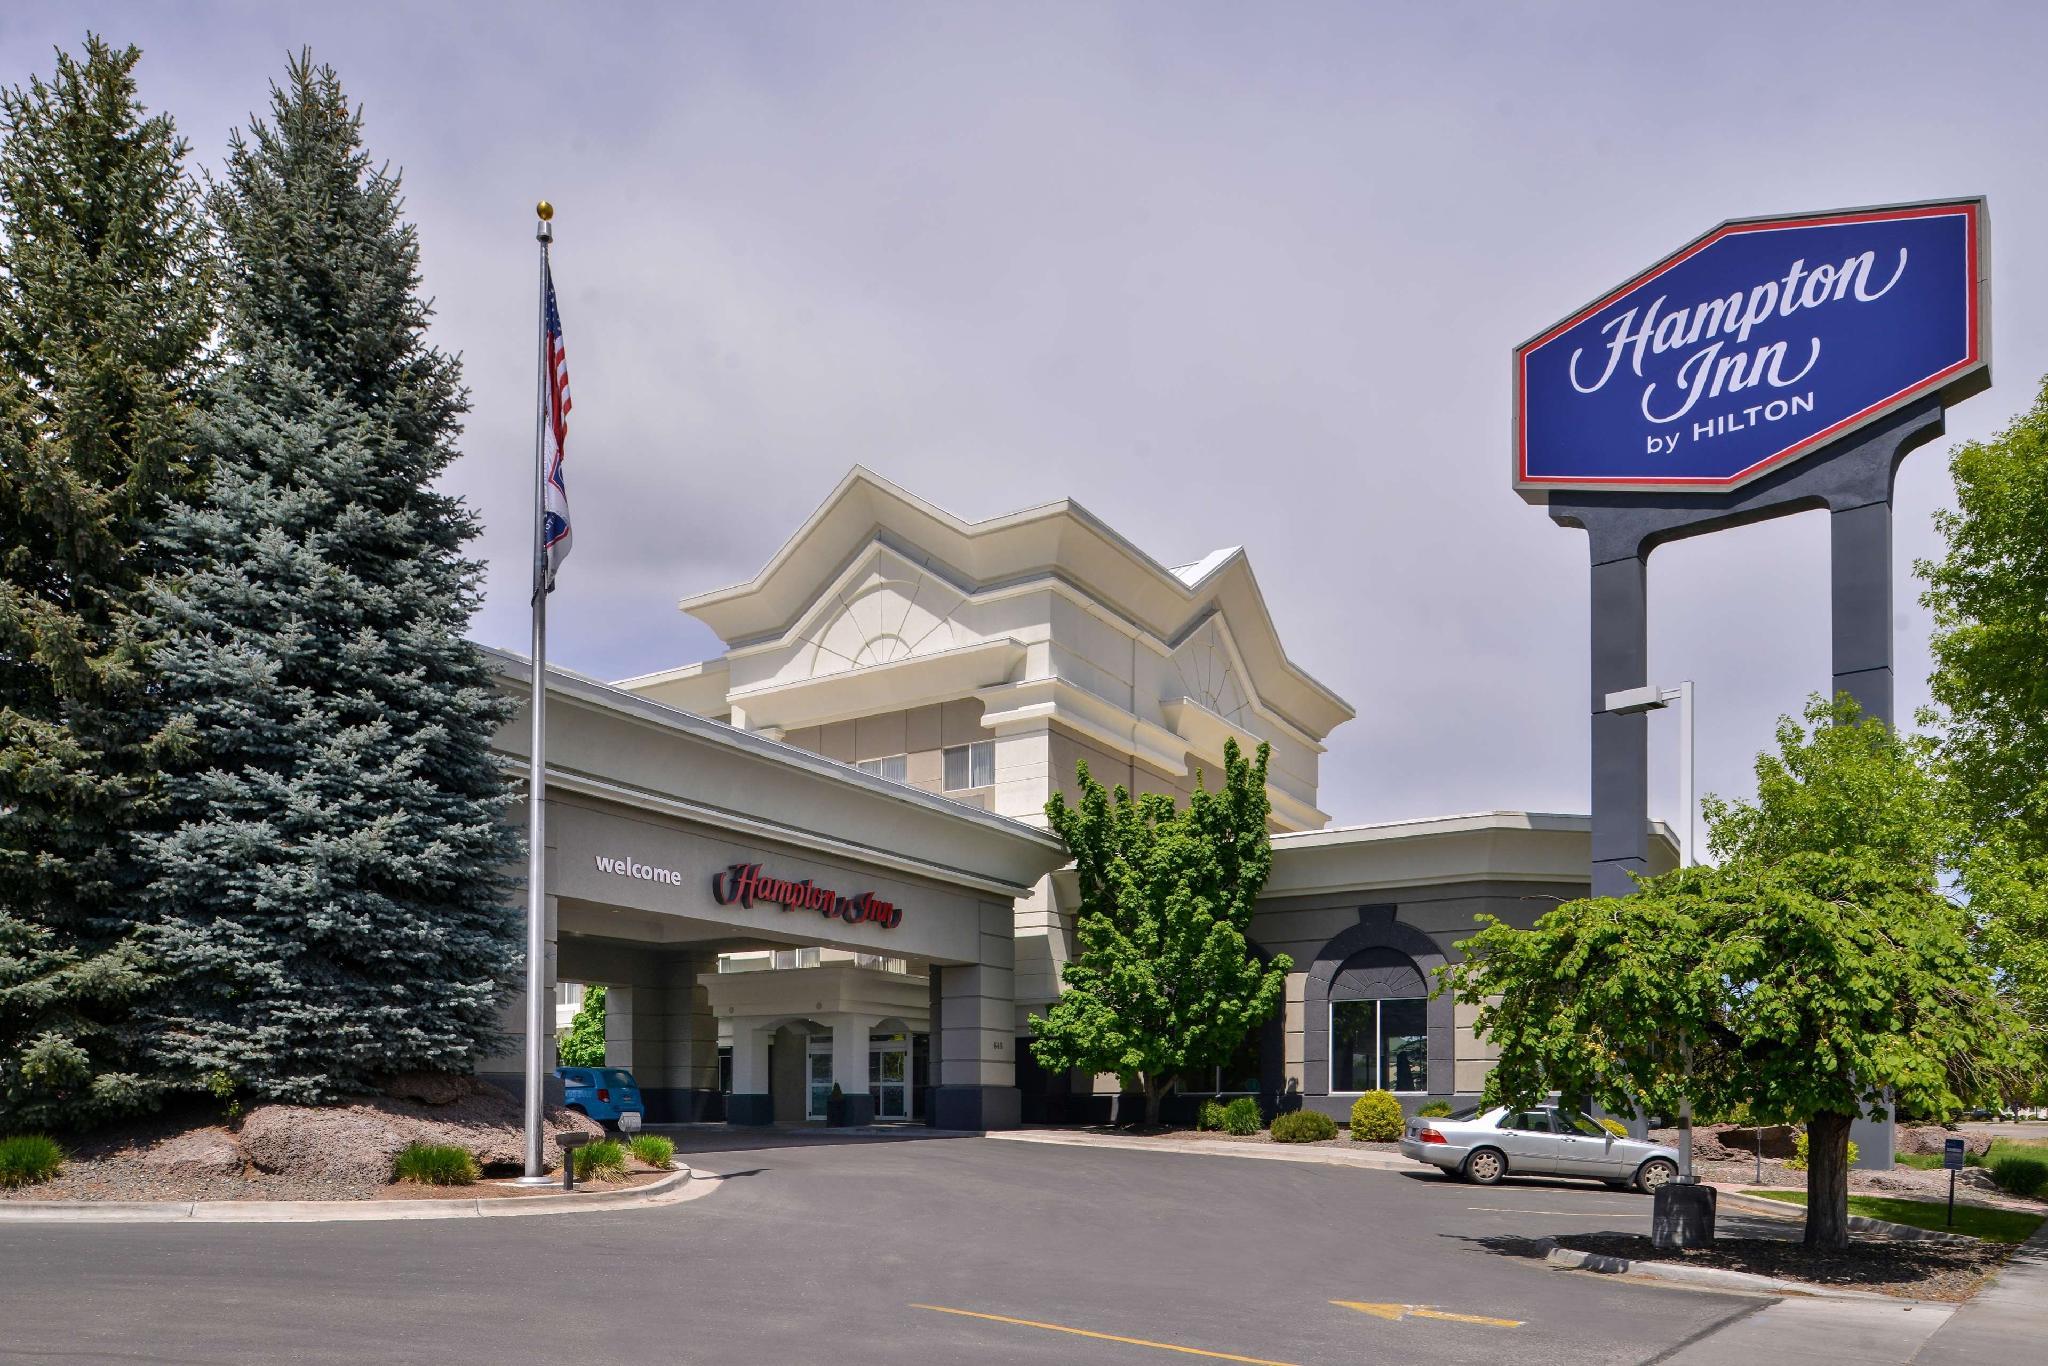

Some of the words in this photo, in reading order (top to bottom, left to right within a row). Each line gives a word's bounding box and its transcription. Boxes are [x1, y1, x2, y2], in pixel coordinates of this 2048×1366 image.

[1570, 247, 1908, 394] Hampton
[1641, 337, 1821, 424] Inn
[1647, 432, 1680, 454] by
[1693, 391, 1814, 442] HILTON
[595, 855, 681, 886] welcome
[712, 863, 846, 919] Hampton
[842, 891, 903, 929] Inn
